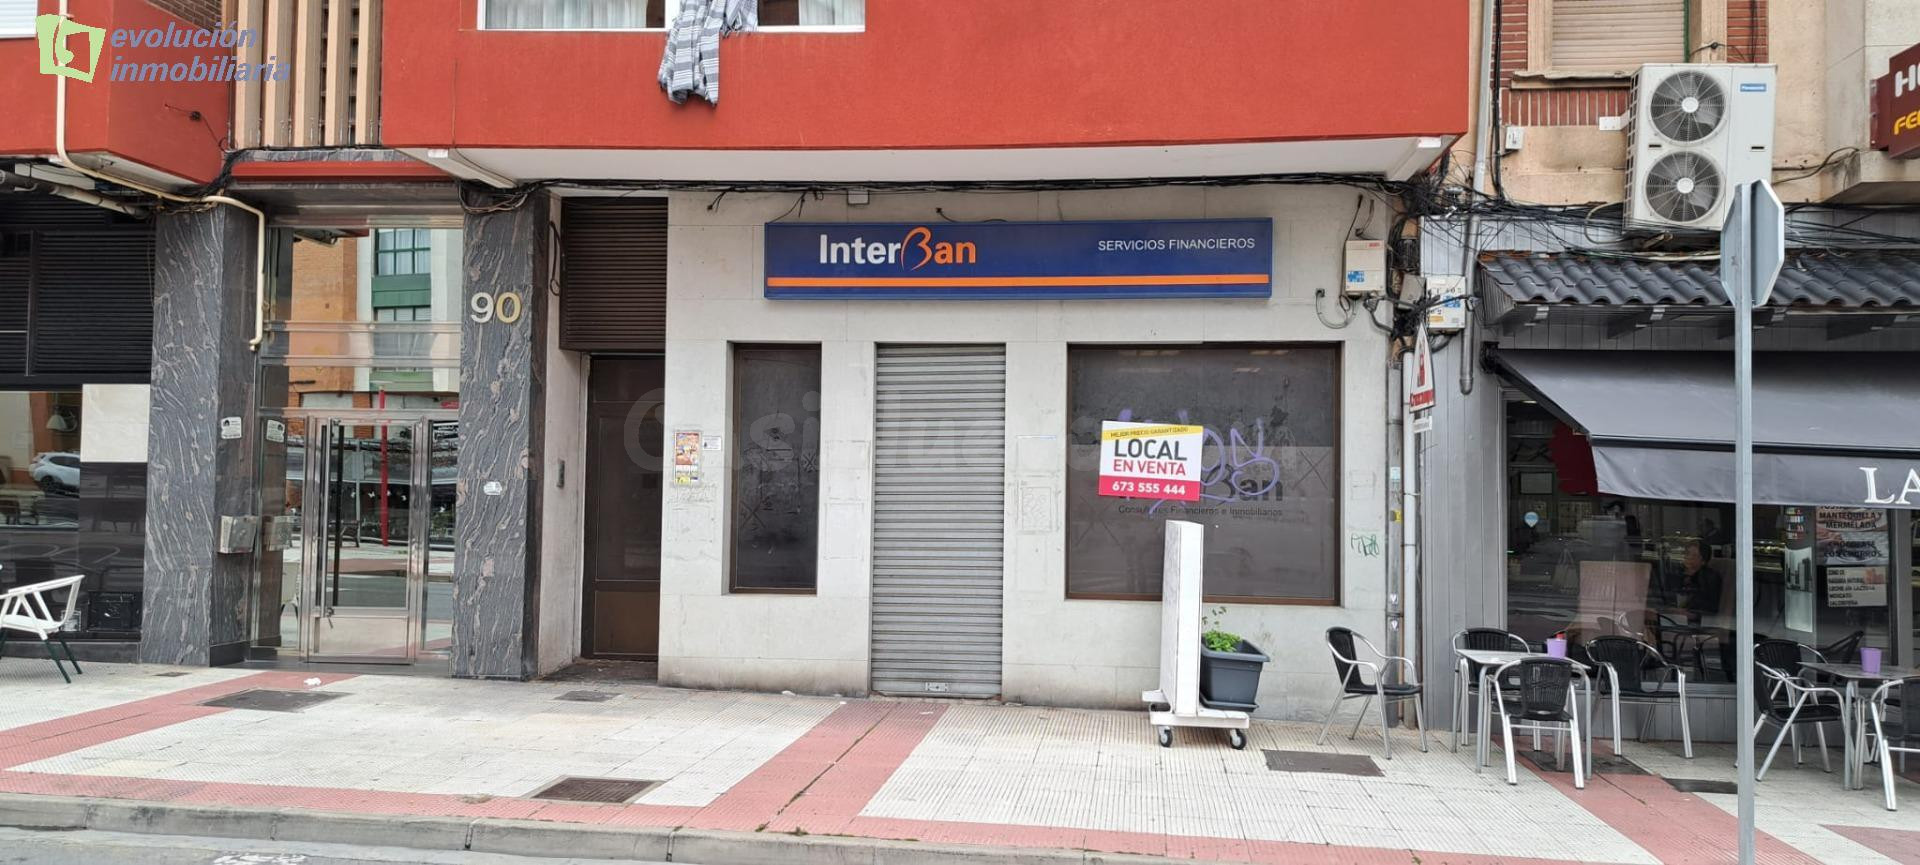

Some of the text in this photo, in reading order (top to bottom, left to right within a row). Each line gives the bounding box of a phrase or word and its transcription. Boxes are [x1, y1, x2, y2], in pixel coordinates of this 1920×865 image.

[820, 226, 976, 271] InterBan
[1098, 238, 1255, 251] SERVICIOS FINANCIEROS
[471, 291, 521, 323] 90
[1114, 438, 1188, 461] LOCAL
[1113, 459, 1186, 476] EN VENTA
[1112, 481, 1186, 495] 673 555 444
